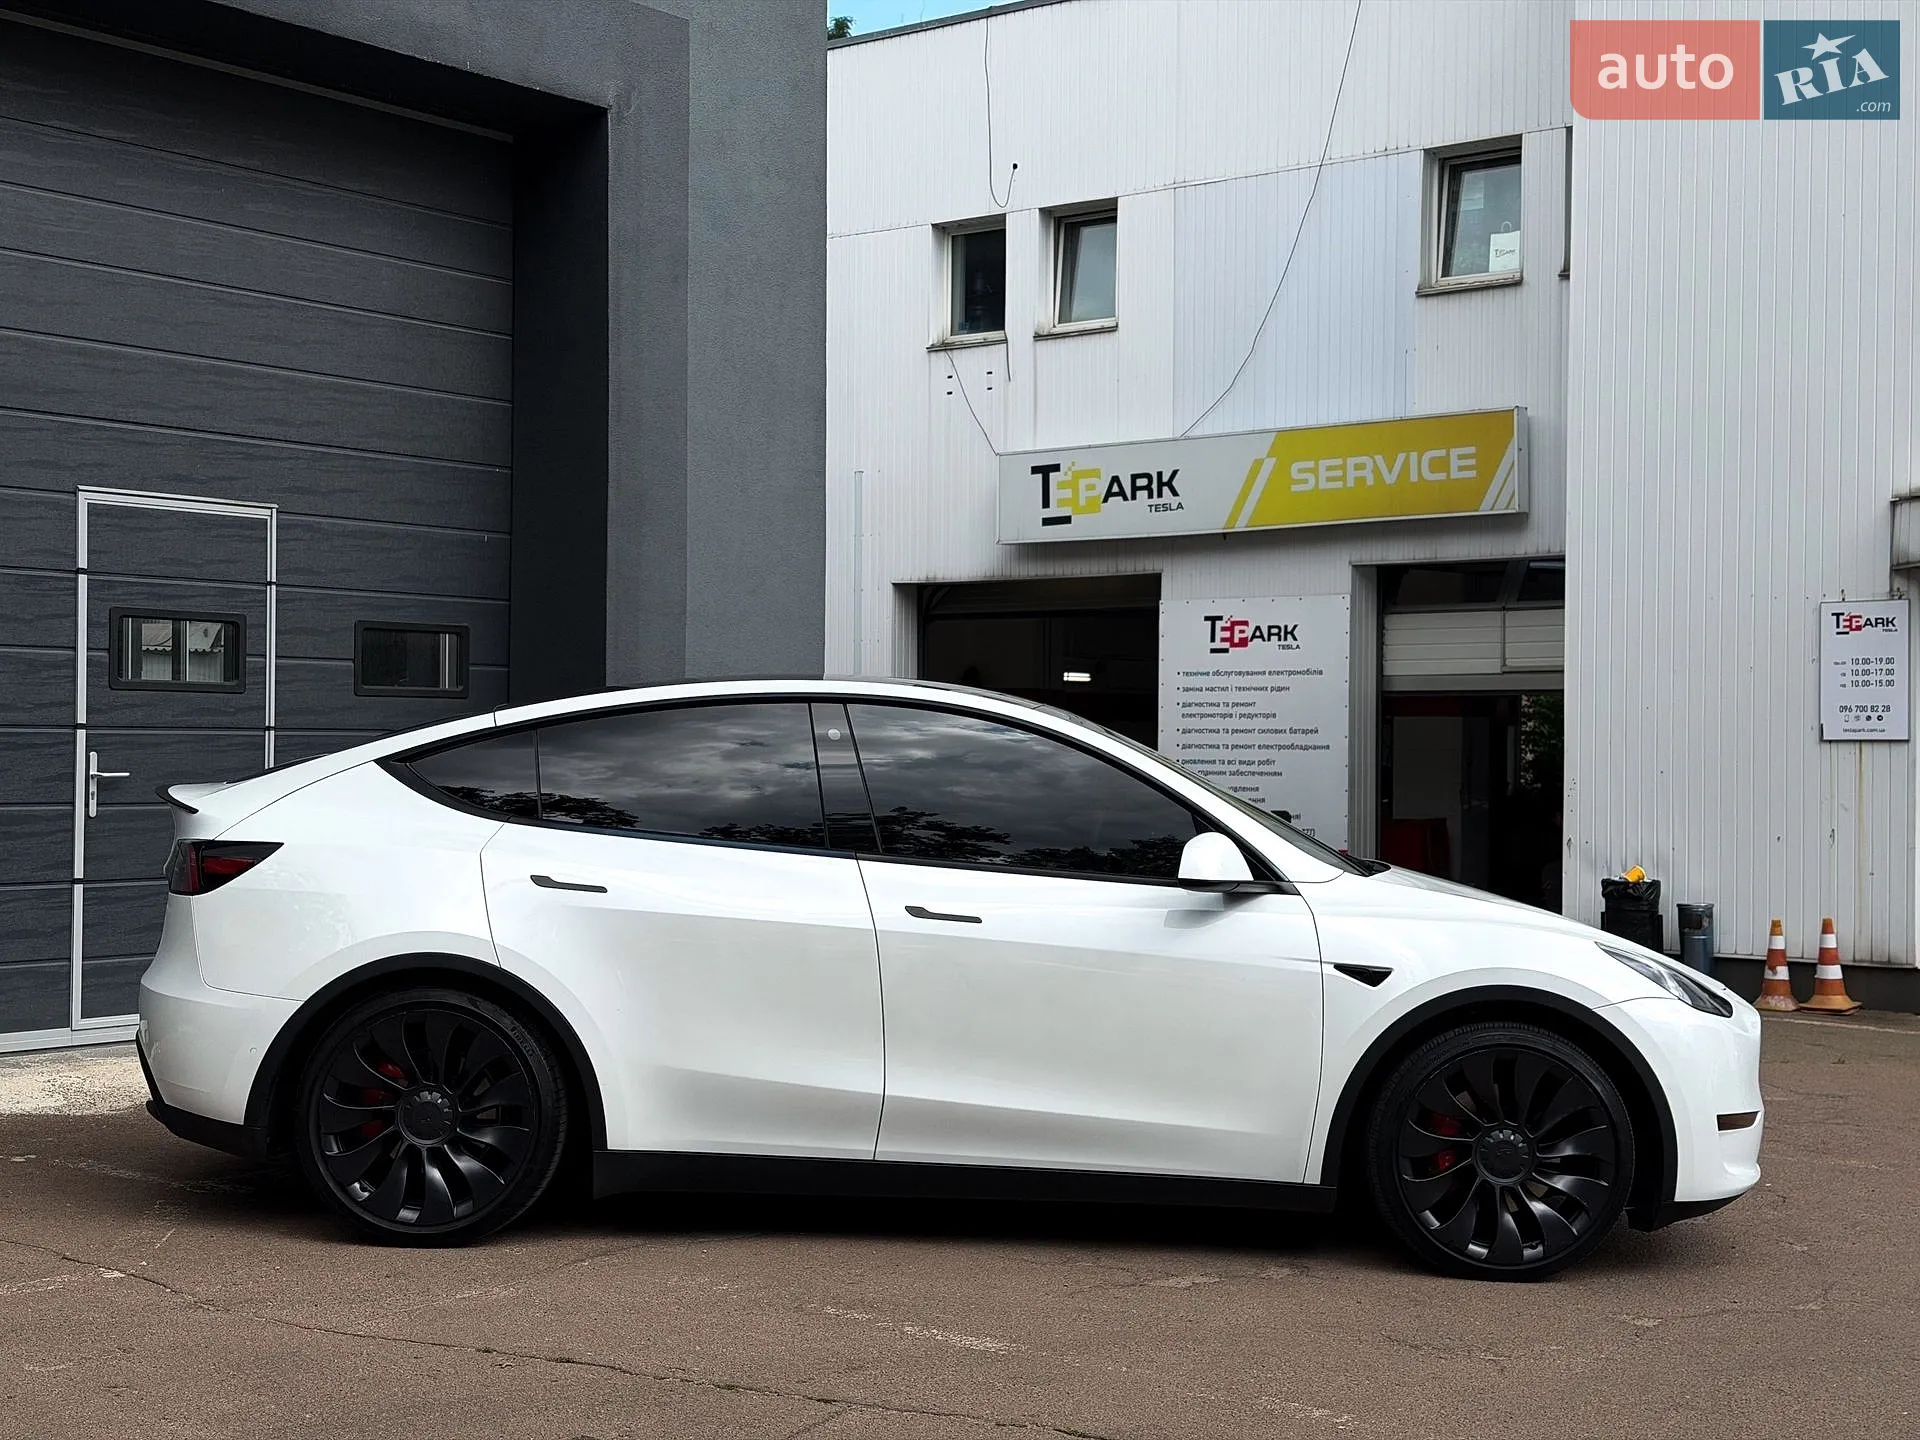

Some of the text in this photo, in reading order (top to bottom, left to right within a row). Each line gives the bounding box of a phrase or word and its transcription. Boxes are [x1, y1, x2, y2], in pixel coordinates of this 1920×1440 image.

[1290, 446, 1478, 493] SERVICE
[1147, 502, 1185, 514] TESLA
[1839, 704, 1891, 713] 096 700 82 28
[1221, 727, 1230, 735] та
